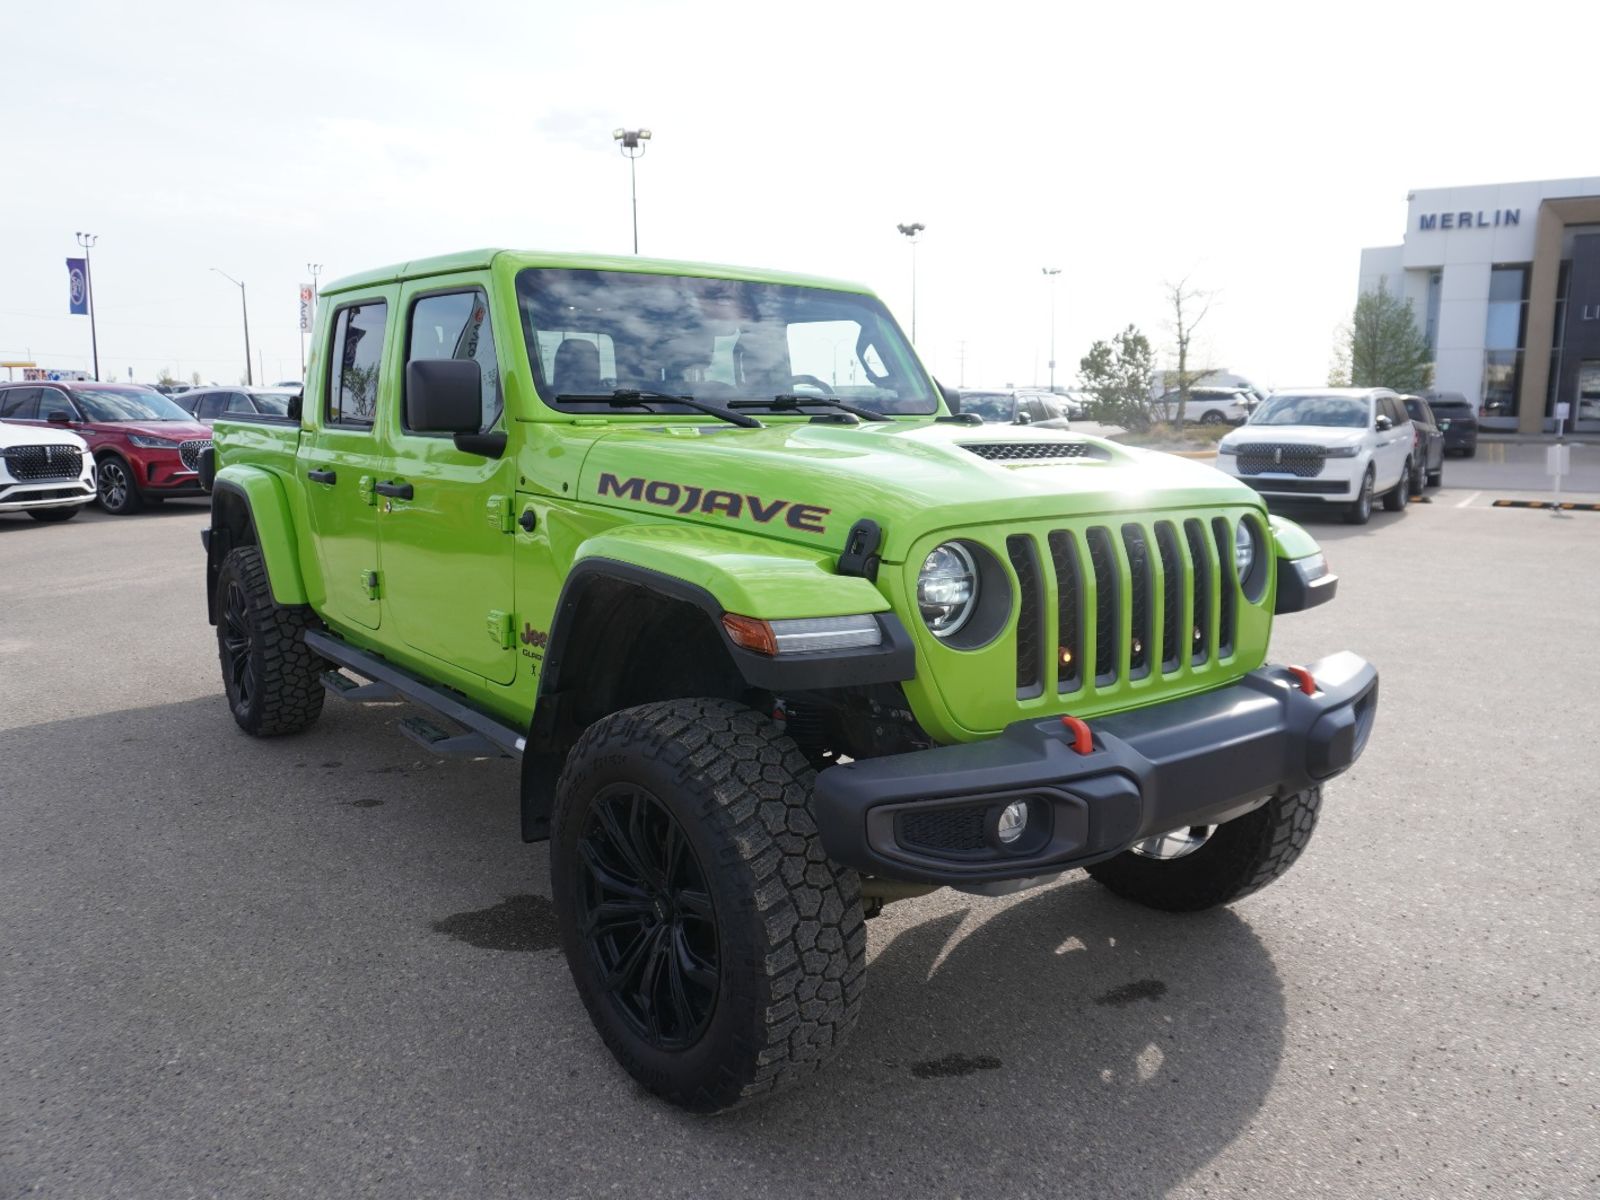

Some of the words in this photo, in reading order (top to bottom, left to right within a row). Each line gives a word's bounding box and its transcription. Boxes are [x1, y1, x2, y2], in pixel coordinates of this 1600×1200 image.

[1419, 209, 1521, 230] MERLIN
[597, 472, 832, 534] MOJAVE
[520, 622, 548, 649] Jee
